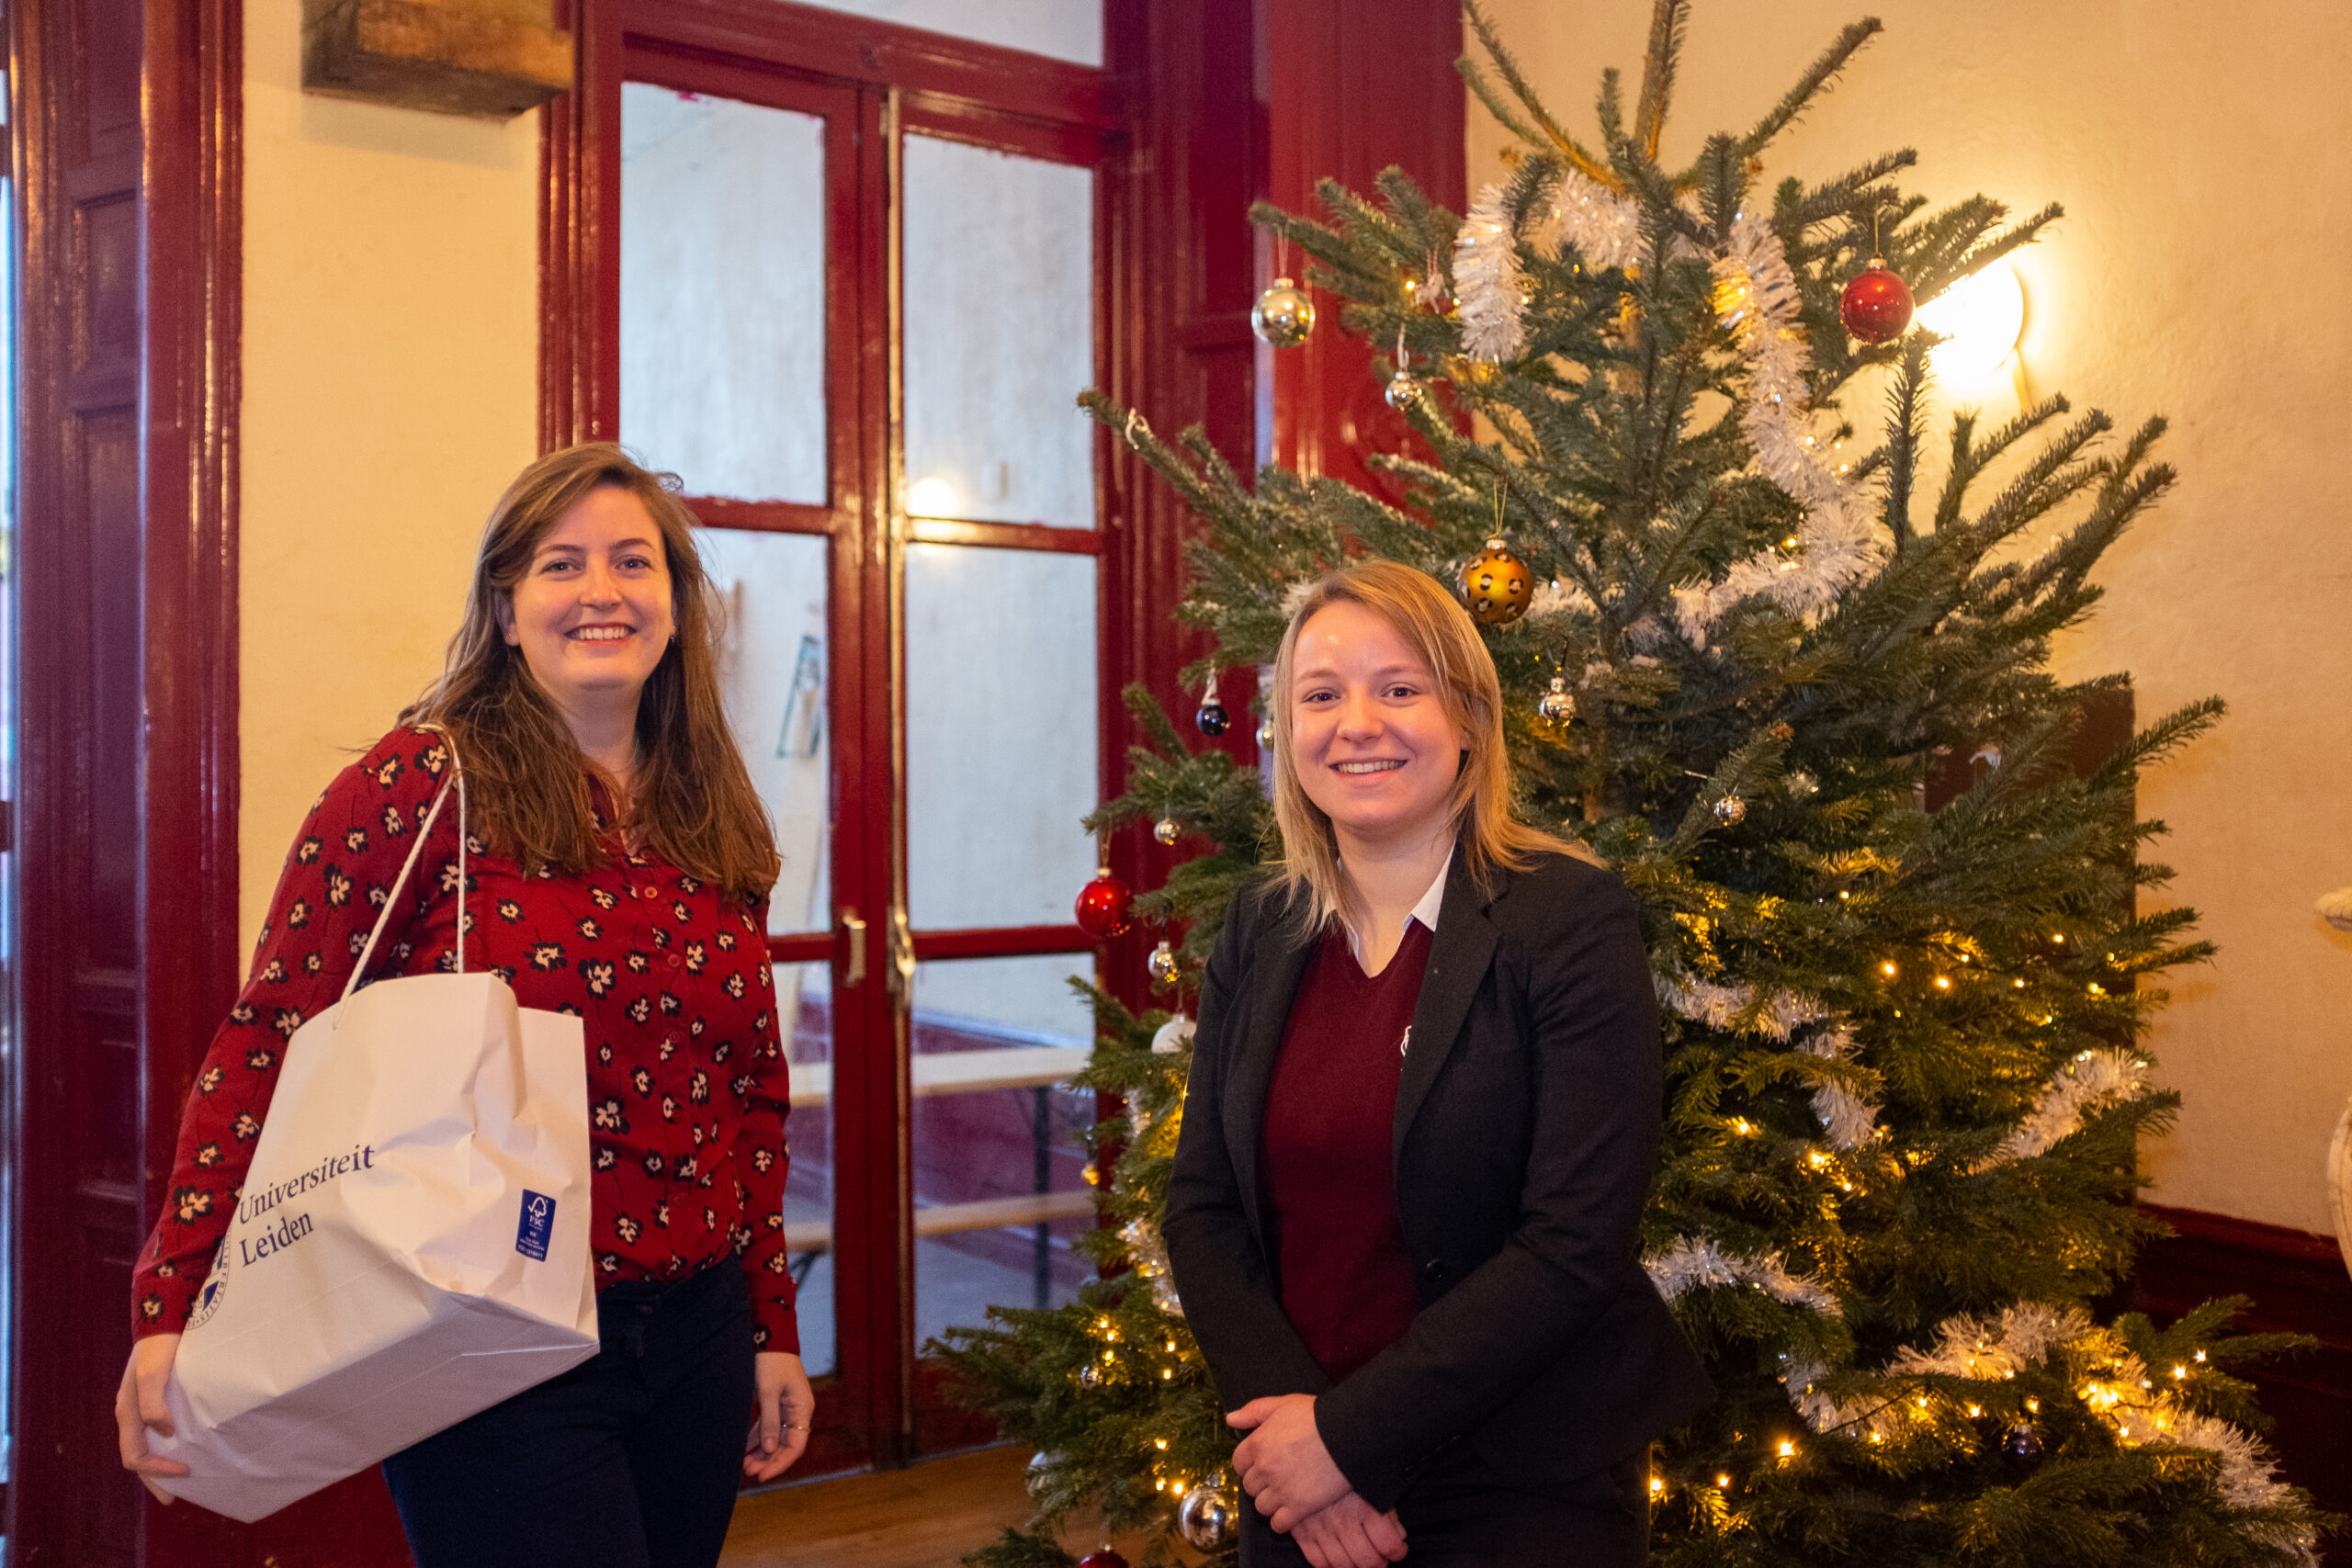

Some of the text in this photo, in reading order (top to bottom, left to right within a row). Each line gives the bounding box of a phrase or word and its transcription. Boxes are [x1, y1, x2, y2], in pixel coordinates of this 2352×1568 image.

[240, 1145, 375, 1224] Universiteit
[239, 1213, 314, 1267] Leiden
[529, 1215, 545, 1227] FSC
